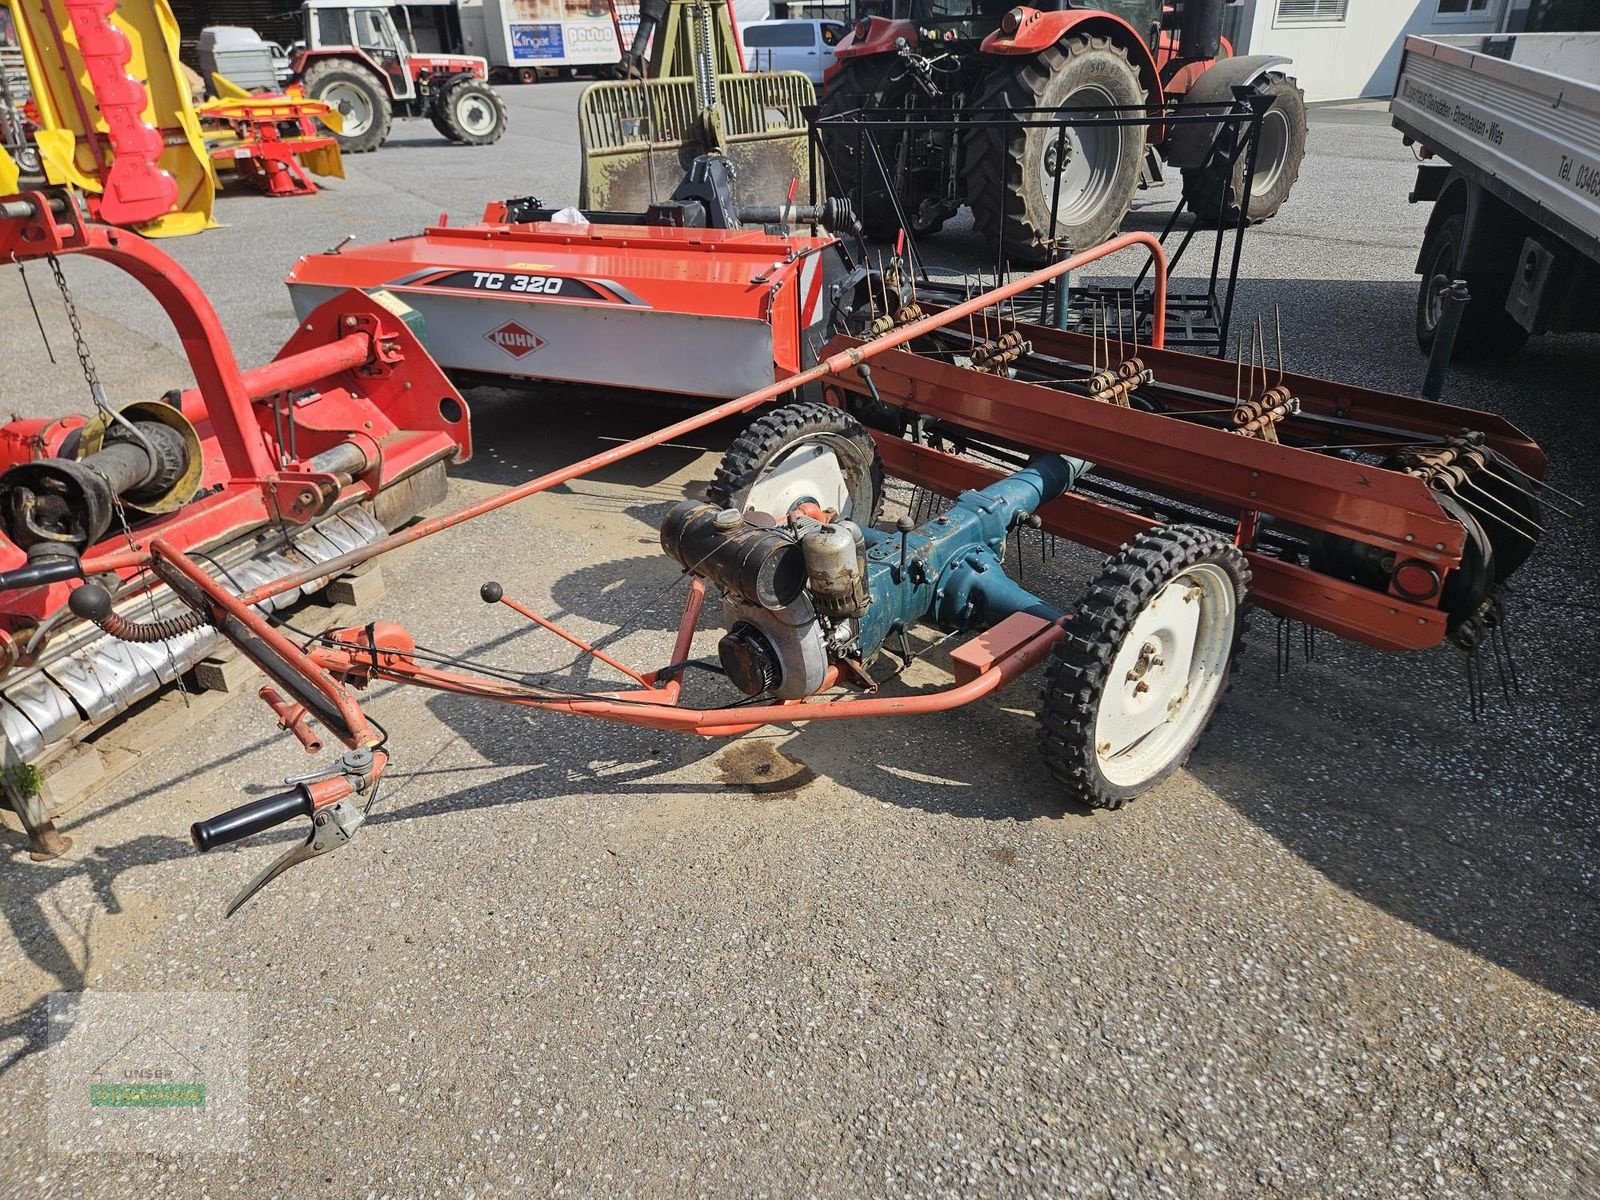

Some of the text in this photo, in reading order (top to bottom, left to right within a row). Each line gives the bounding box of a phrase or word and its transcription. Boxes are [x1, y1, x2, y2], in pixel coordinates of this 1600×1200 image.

[1453, 105, 1486, 136] Ehrenhausen
[1488, 120, 1504, 146] Wies
[1557, 154, 1573, 183] Tel.
[473, 271, 563, 294] TC 320
[494, 332, 537, 348] KUHN
